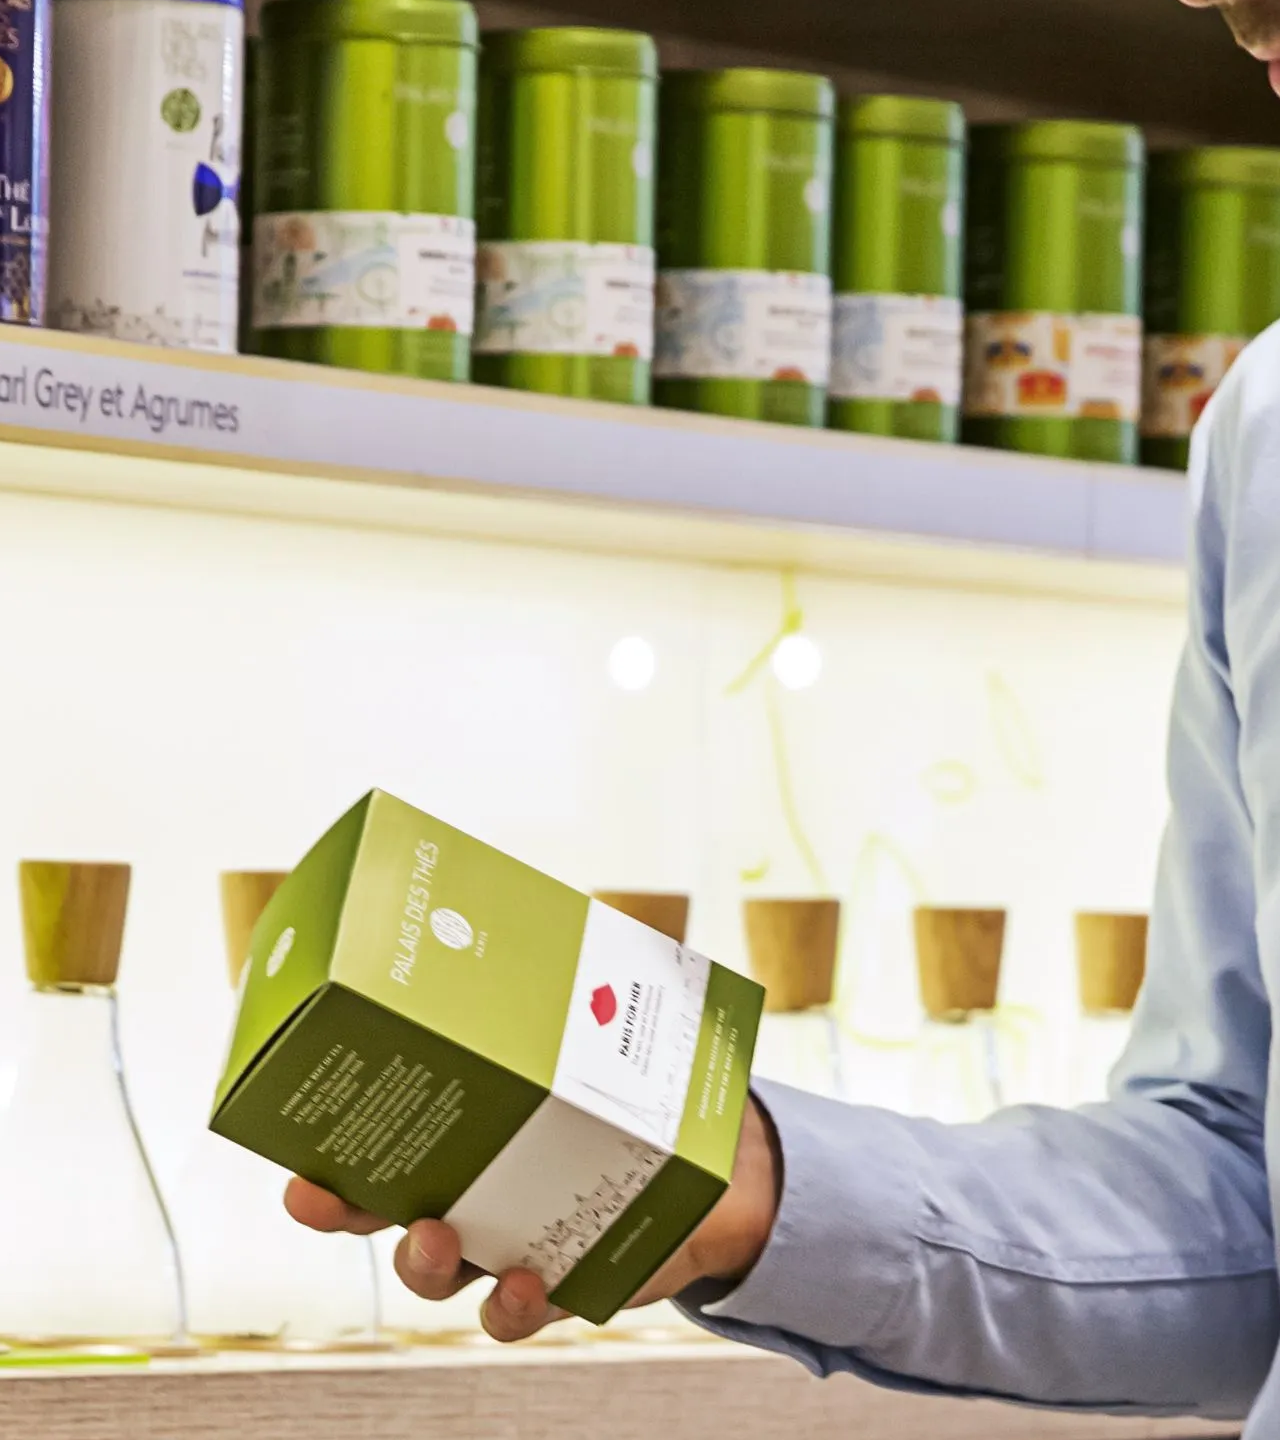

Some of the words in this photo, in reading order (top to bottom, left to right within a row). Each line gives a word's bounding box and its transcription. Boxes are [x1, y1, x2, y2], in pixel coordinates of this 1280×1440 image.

[34, 368, 94, 423] Grey
[99, 382, 125, 418] et
[129, 384, 240, 434] Agrumes
[403, 883, 431, 924] DES
[389, 921, 422, 987] PALAIS
[630, 980, 642, 1005] HER
[625, 1003, 638, 1028] FOR
[619, 1025, 634, 1058] PARIS
